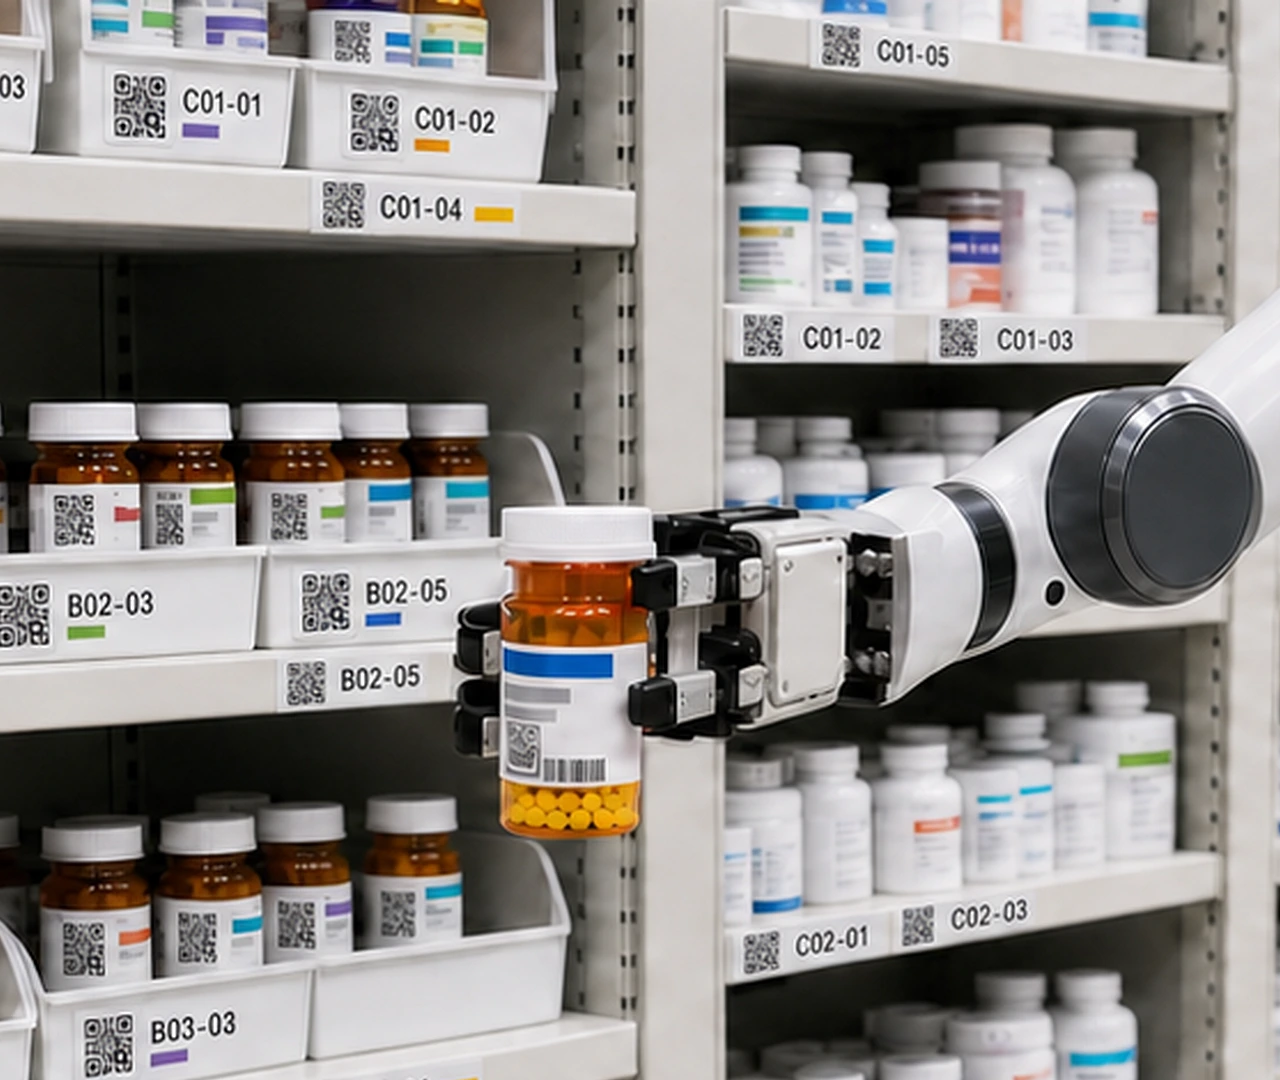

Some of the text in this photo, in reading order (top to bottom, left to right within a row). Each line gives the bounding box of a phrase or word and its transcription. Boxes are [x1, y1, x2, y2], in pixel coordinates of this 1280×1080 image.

[877, 38, 950, 68] C01-05
[182, 88, 261, 117] C01-01
[414, 105, 495, 134] C01-02
[380, 194, 462, 221] C01-04
[803, 325, 881, 350] C01-02
[997, 327, 1074, 352] C01-03
[68, 590, 154, 618] B02-03
[366, 578, 448, 606] B02-05
[341, 663, 420, 692] B02-05
[951, 898, 1028, 931] C02-03
[795, 925, 867, 957] C02-01
[151, 1010, 236, 1045] B03-03
